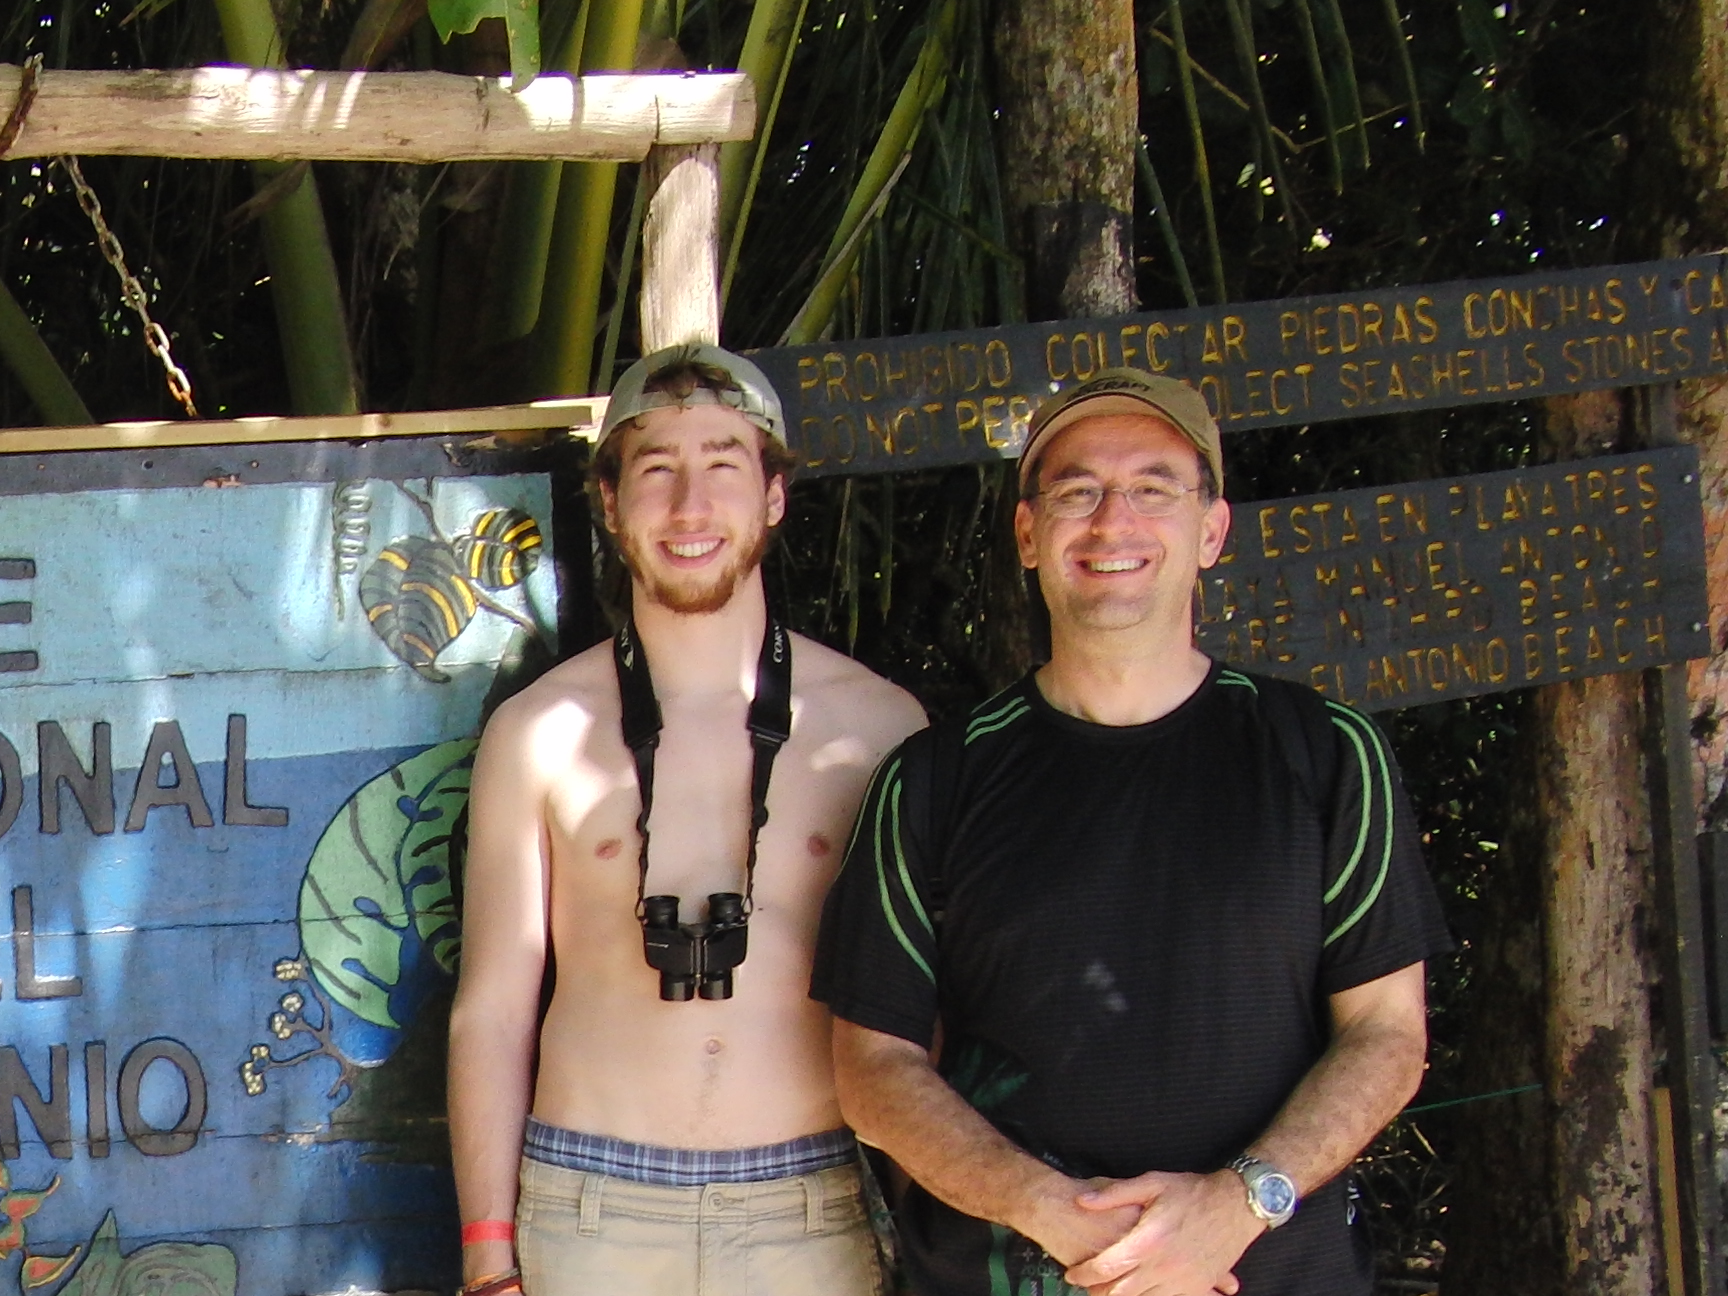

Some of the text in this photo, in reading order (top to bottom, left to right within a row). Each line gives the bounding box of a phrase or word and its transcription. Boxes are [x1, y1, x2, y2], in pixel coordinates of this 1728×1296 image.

[797, 339, 1013, 403] PROHIBIDO
[1046, 315, 1249, 382] COLECTAR
[1279, 296, 1439, 355] PIEDRAS
[1463, 278, 1627, 339] CONCHAS
[1638, 274, 1659, 314] Y
[801, 414, 857, 468] DO
[865, 402, 944, 456] NOT
[956, 394, 1043, 450] PER
[1186, 363, 1314, 421] OLECT
[1339, 341, 1545, 408] SEASHELLS
[1562, 326, 1694, 383] STONES
[1259, 502, 1360, 559] ESTA
[1376, 492, 1428, 543] EN
[1564, 463, 1661, 517] TRES
[1196, 570, 1293, 623] LAYA
[1315, 541, 1470, 600] MANUEL
[1366, 636, 1509, 700] ANTONIO
[1523, 615, 1666, 680] BEACH
